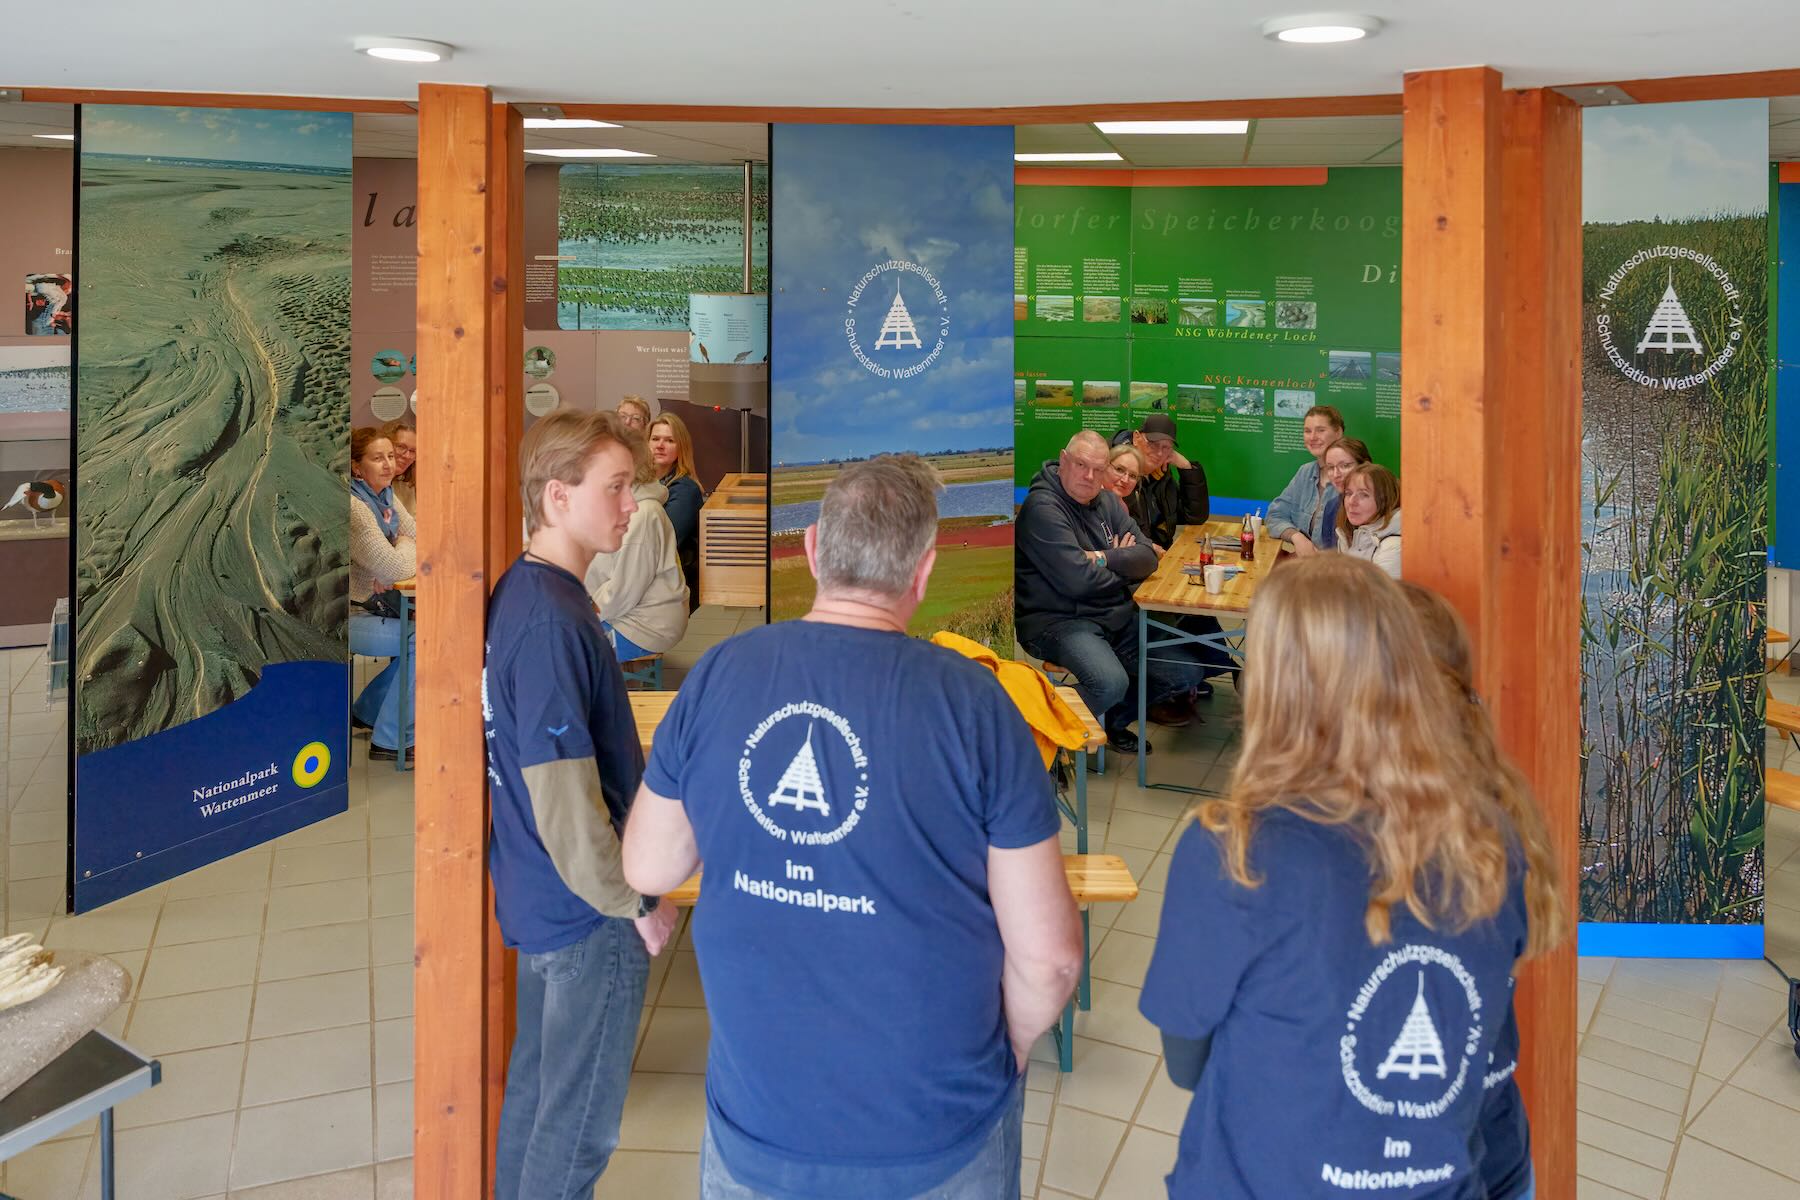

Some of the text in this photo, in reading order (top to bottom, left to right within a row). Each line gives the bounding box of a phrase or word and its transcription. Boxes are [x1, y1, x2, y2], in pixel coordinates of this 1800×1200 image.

[1141, 207, 1401, 239] Speicherkoog
[847, 259, 948, 307] Naturschutzgesellschaft
[1599, 244, 1740, 301] Naturschutzgesellschaft
[636, 345, 650, 353] Wer
[845, 315, 950, 380] Schutzstation Wattenmeer e.V.
[1174, 327, 1318, 342] NSG Wöhrdener Loch
[1597, 314, 1745, 391] Schutzstation Wattenmeer e.V.
[1203, 374, 1233, 386] NSG
[1237, 375, 1318, 390] Kronenloch
[745, 700, 869, 769] Naturschutzgesellschaft
[193, 763, 279, 803] Nationalpark
[200, 783, 279, 818] Wattenmeer
[738, 757, 869, 846] Schutzstation Wattenmeer e.V.
[785, 860, 814, 882] im
[733, 869, 877, 915] Nationalpark
[1347, 944, 1483, 1021] Naturschutzgesellschaft
[1383, 1136, 1412, 1159] im
[1321, 1162, 1456, 1190] Nationalpark
